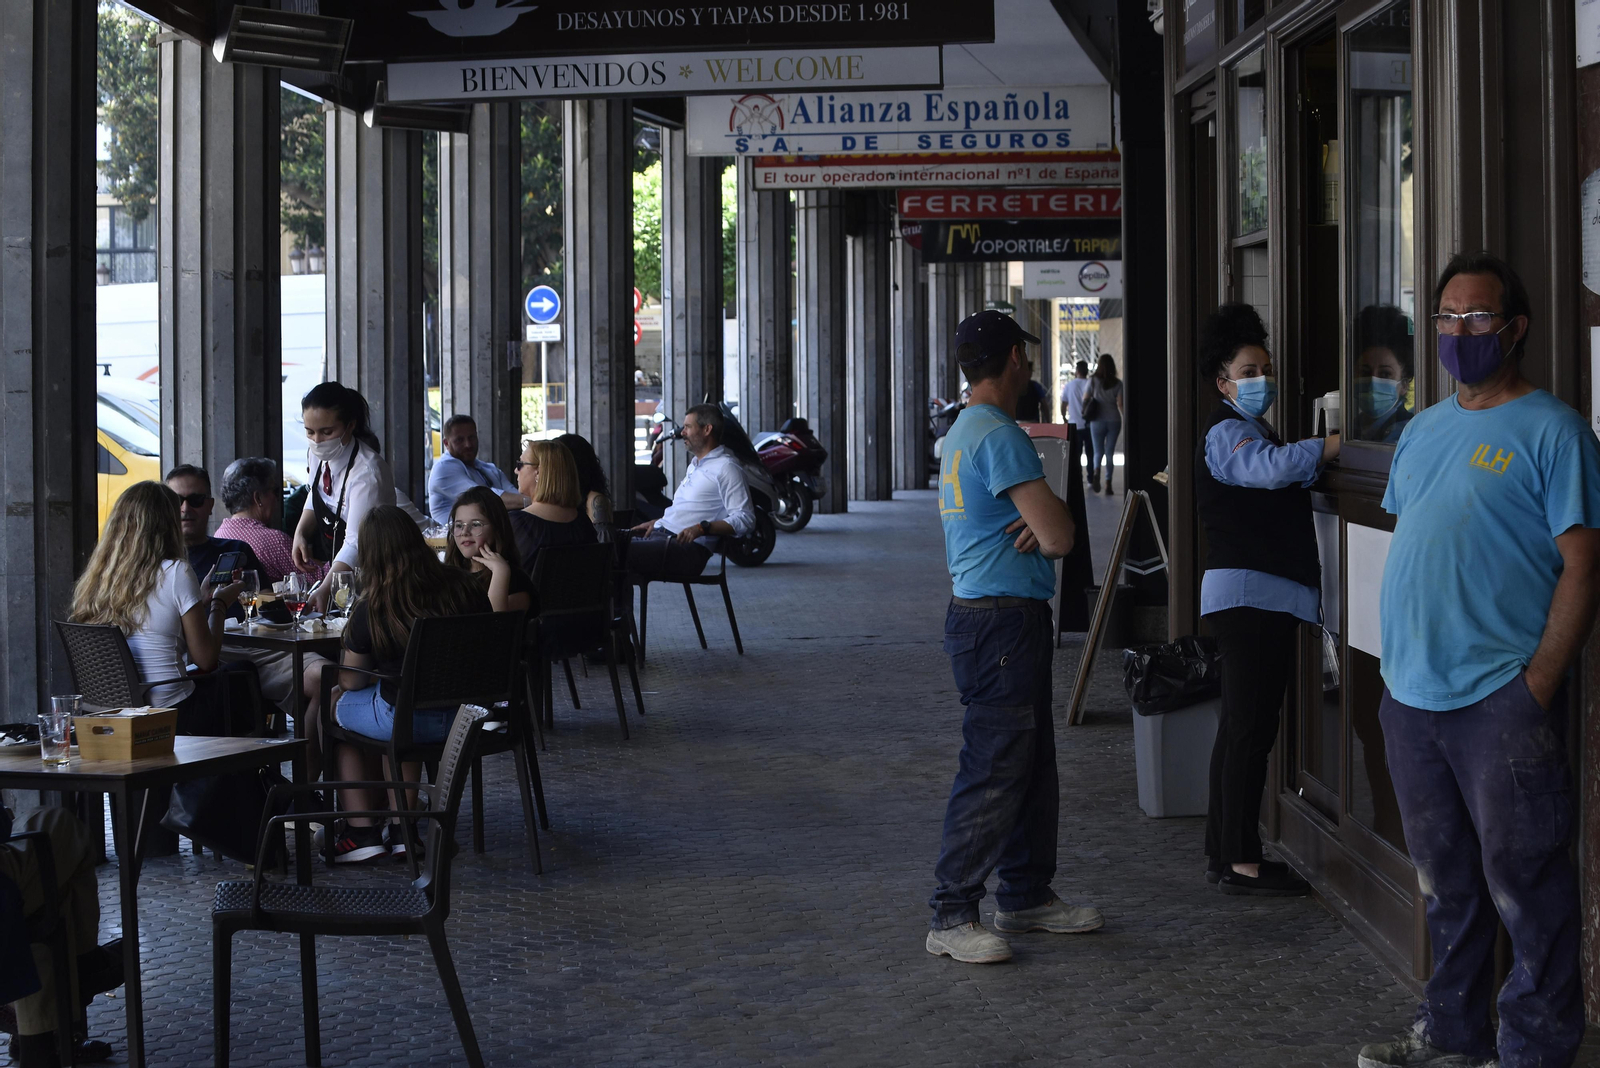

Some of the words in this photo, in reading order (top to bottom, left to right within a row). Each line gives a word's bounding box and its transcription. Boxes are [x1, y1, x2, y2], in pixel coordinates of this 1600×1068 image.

[557, 8, 686, 31] DESAYUNOS
[689, 7, 705, 26] Y
[708, 5, 774, 25] TAPAS
[779, 3, 852, 23] DESDE
[858, 2, 910, 21] 1.981
[460, 60, 666, 93] BIENVENIDOS
[703, 55, 864, 83] WELCOME
[790, 94, 912, 124] Alianza
[924, 91, 1070, 129] Española
[842, 136, 878, 151] DE
[917, 132, 1070, 150] SEGUROS
[764, 172, 776, 184] El
[784, 173, 816, 183] tour
[822, 170, 891, 185] operador
[899, 168, 1000, 182] internacional
[1038, 167, 1057, 180] de
[1065, 166, 1120, 182] España
[1073, 237, 1119, 253] TAPAS
[1470, 443, 1514, 472] ILH
